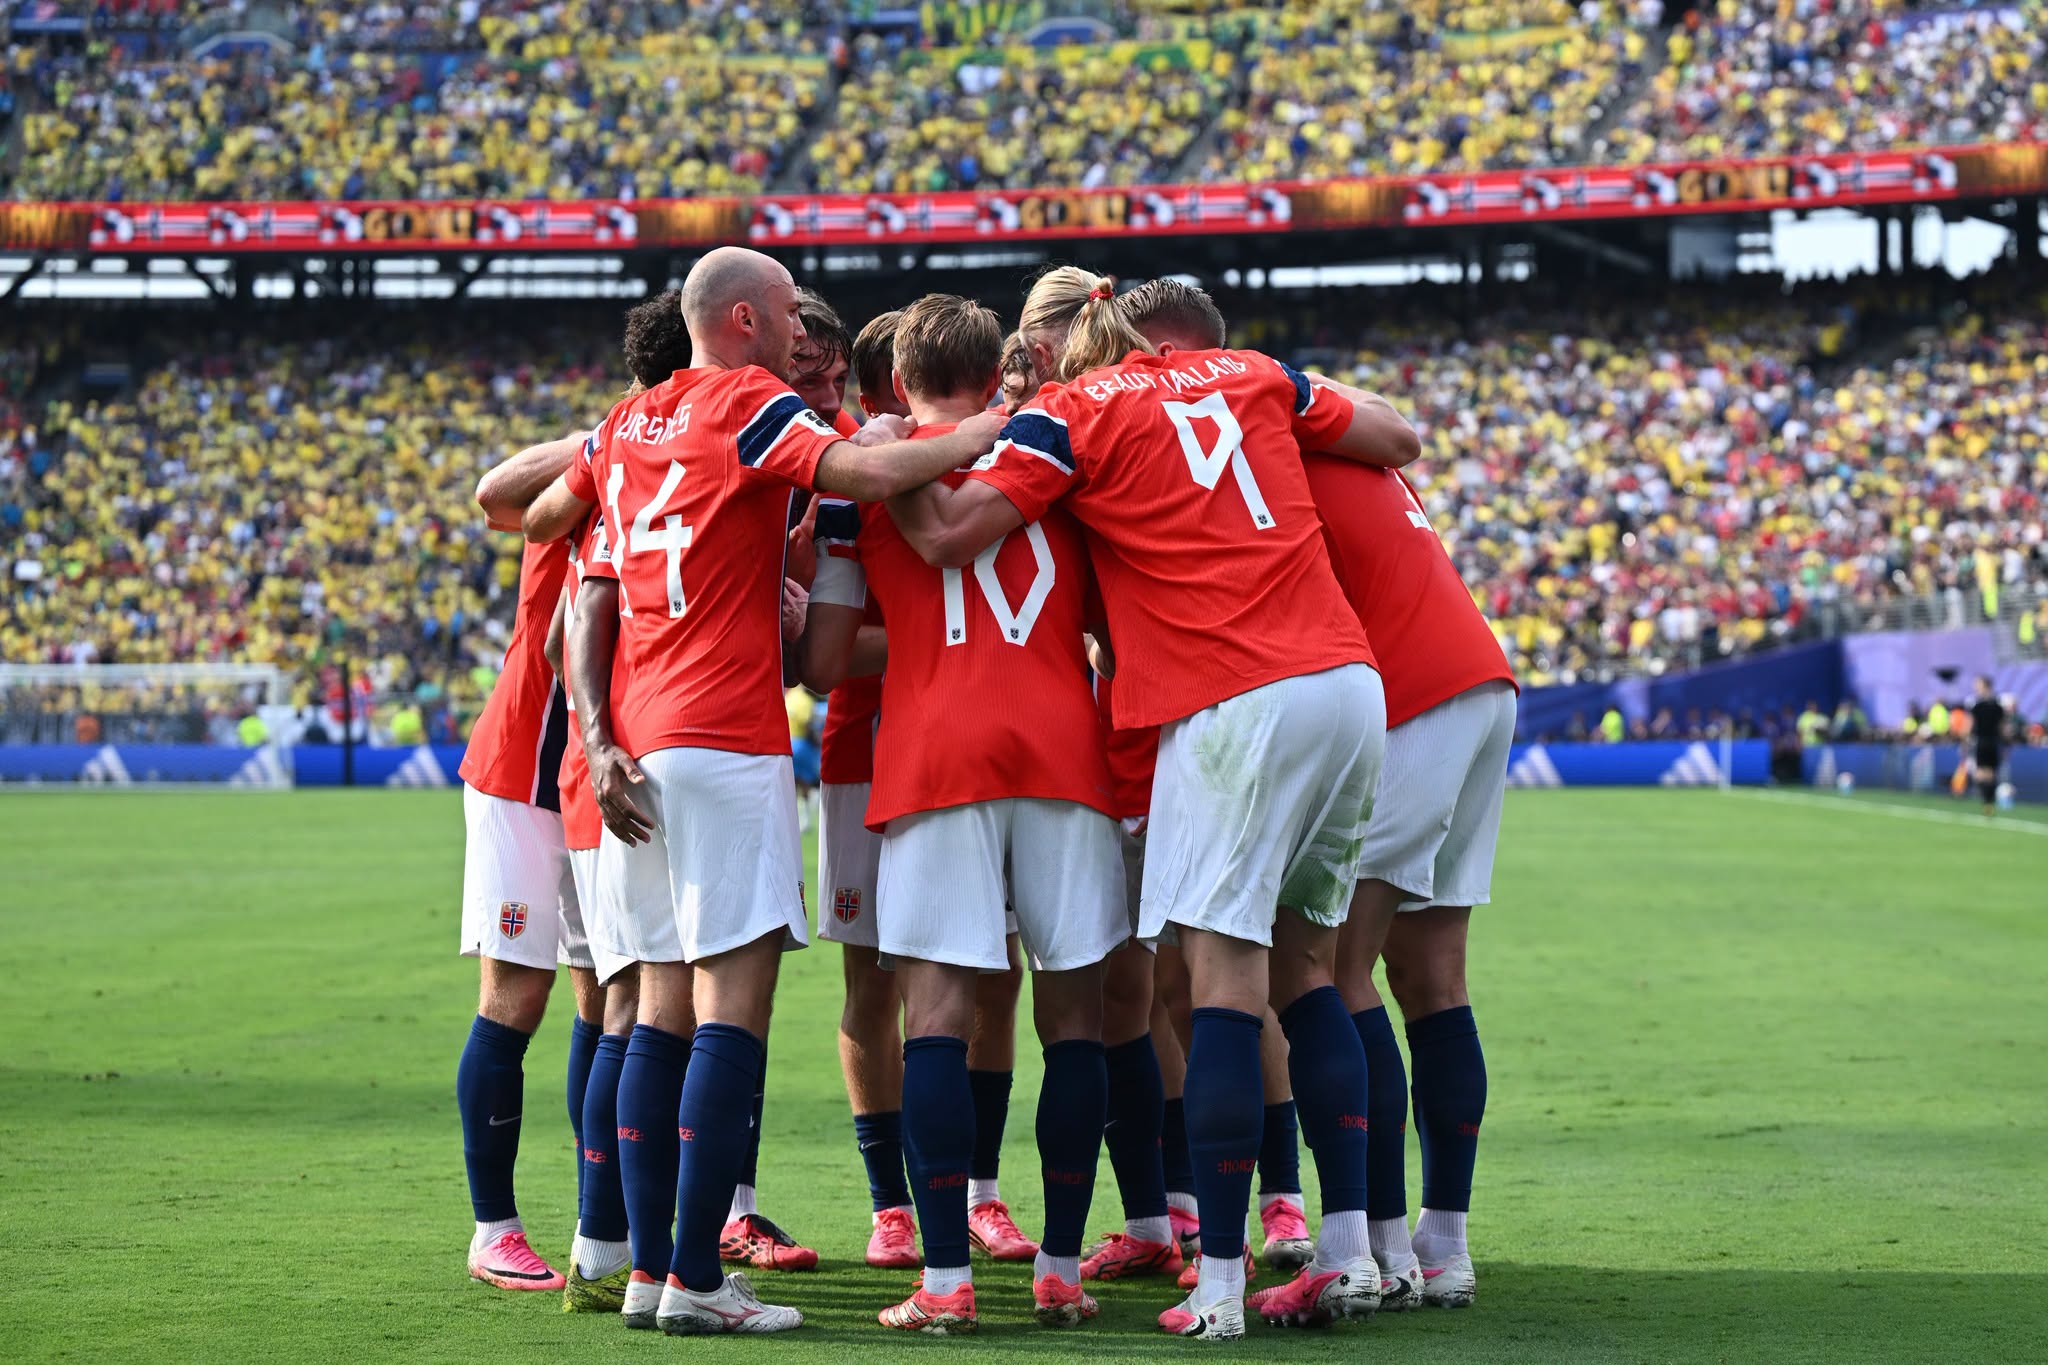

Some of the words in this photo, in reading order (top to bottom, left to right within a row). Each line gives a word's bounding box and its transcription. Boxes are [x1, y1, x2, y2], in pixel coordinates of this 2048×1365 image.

[1084, 373, 1157, 401] BRAUT
[1162, 391, 1276, 529] 9
[606, 459, 693, 618] 14
[942, 520, 1056, 647] 10
